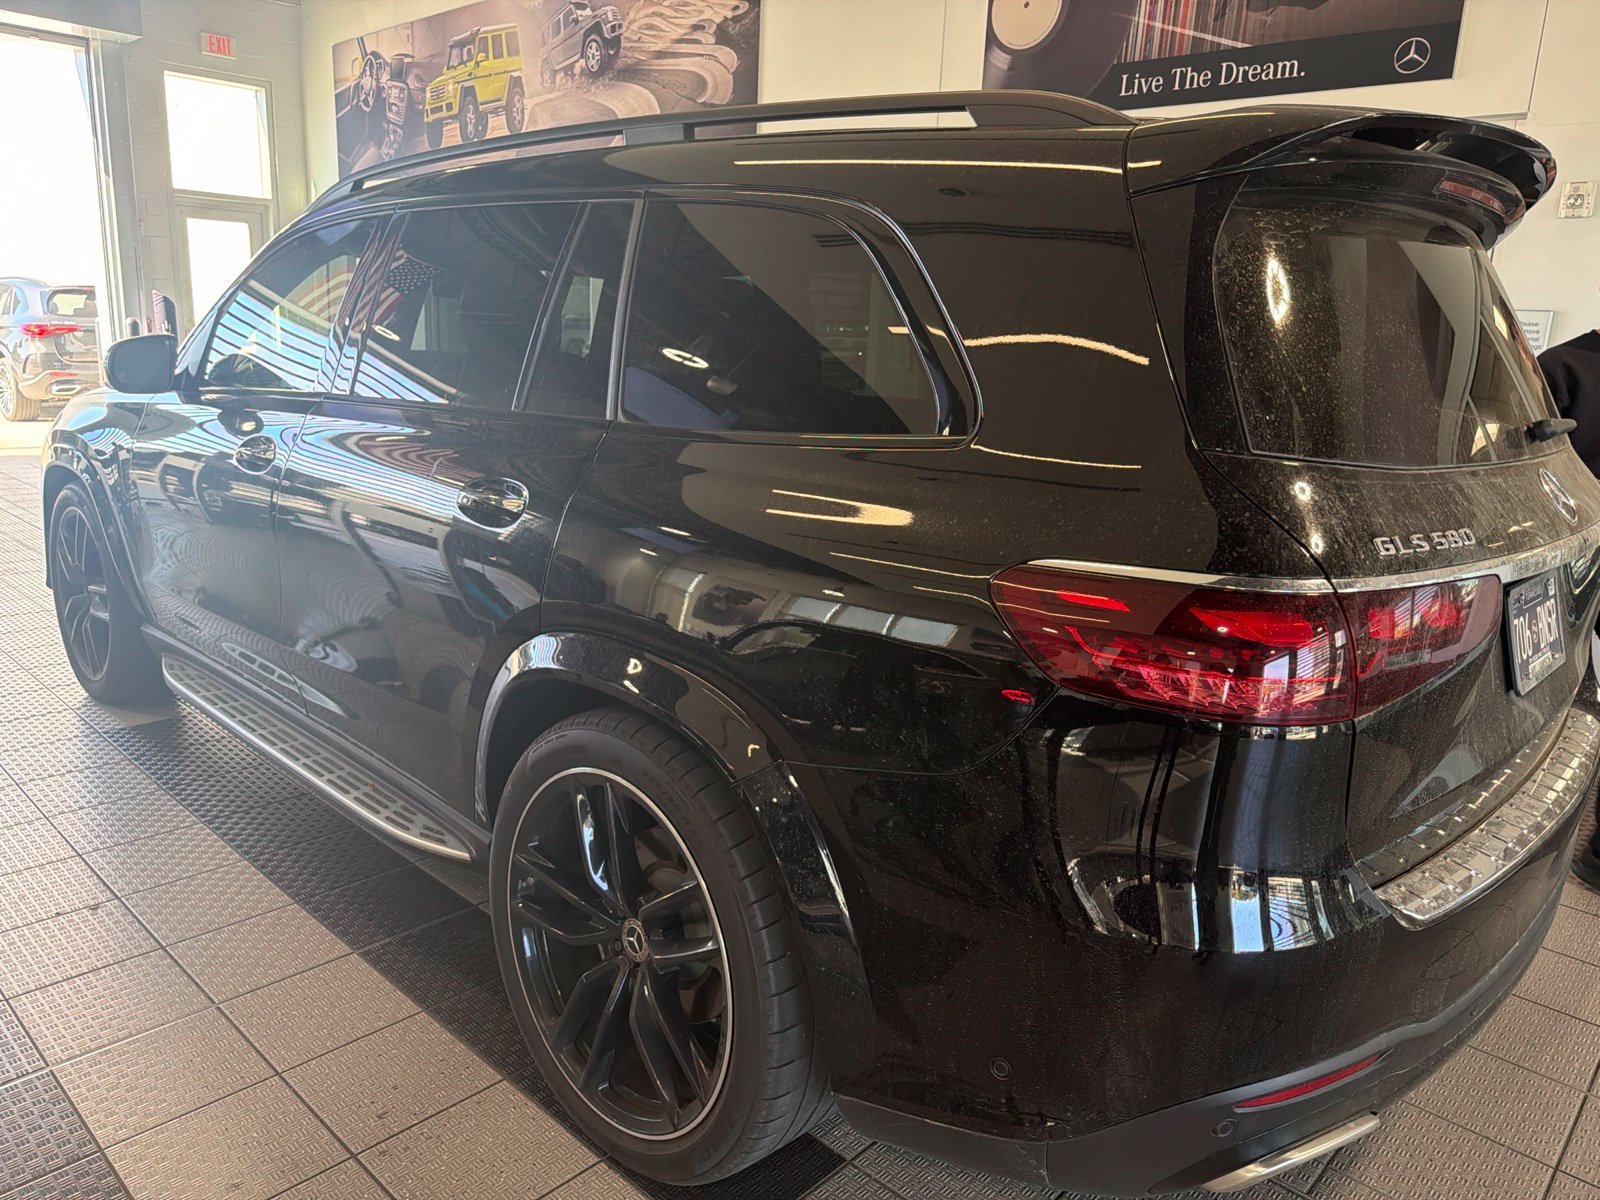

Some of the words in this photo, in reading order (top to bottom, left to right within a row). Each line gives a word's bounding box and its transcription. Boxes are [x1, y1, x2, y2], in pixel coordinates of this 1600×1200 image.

[208, 35, 231, 57] EXIT
[1119, 73, 1164, 97] Live
[1171, 67, 1212, 91] The
[1218, 58, 1306, 87] Dream.
[1373, 534, 1431, 556] GLS
[1430, 527, 1477, 551] 580
[1513, 612, 1533, 664] 706
